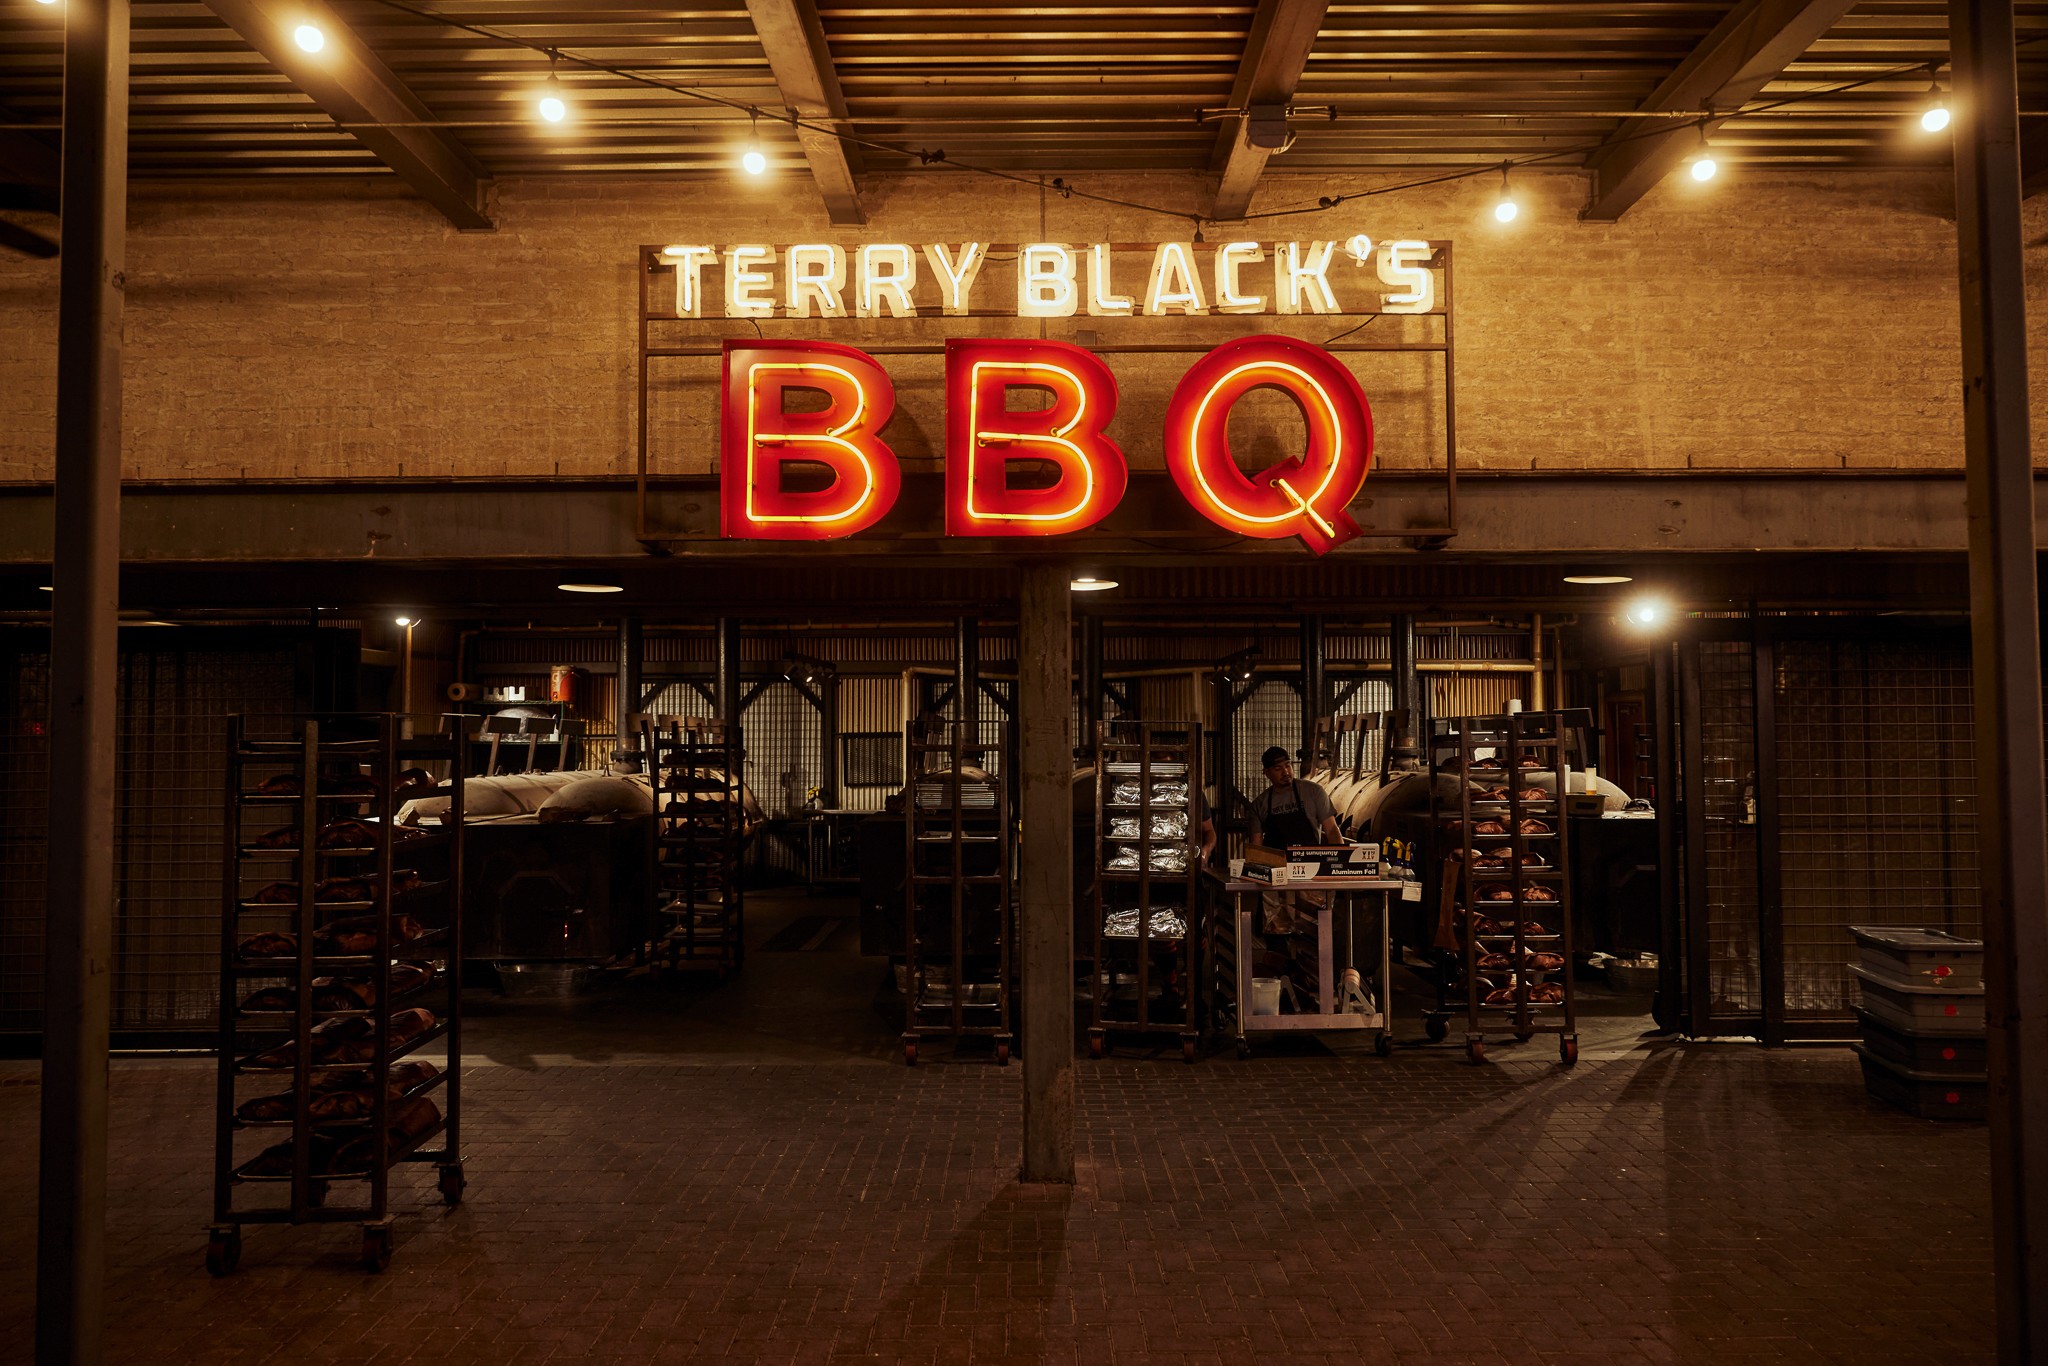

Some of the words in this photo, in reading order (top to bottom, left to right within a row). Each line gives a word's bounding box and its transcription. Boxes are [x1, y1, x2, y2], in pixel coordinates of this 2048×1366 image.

[659, 243, 991, 318] TERRY
[1018, 235, 1434, 316] BLACK'S
[721, 335, 1371, 556] BBQ
